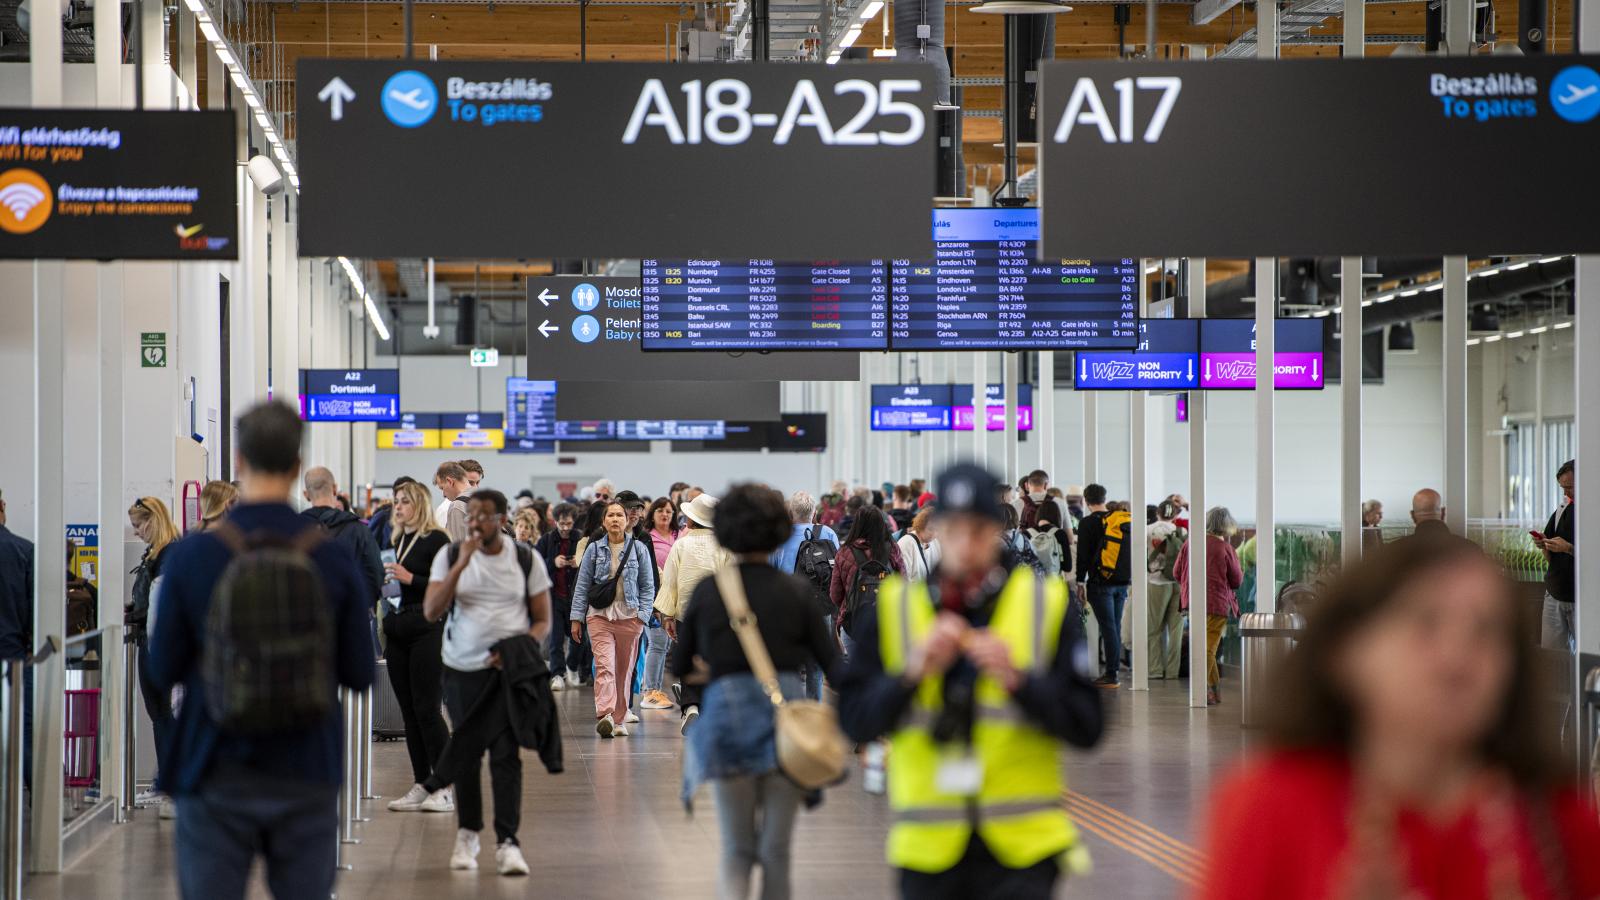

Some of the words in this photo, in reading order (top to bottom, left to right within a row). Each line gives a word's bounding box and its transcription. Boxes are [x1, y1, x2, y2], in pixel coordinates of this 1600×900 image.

[447, 77, 552, 99] Beszállás
[1430, 72, 1538, 96] Beszállás
[448, 100, 477, 121] To
[480, 101, 543, 126] gates
[621, 78, 925, 145] A18-A25
[1053, 77, 1182, 143] A17
[1440, 95, 1470, 118] To
[1473, 98, 1537, 122] gates
[23, 144, 47, 160] for
[50, 146, 83, 164] you
[994, 220, 1038, 228] Departures
[605, 298, 641, 308] Toilets
[605, 330, 634, 341] Baby
[1138, 362, 1160, 370] NON
[1273, 366, 1307, 374] IORITY
[345, 372, 361, 381] A22
[1138, 371, 1182, 379] PRIORITY
[330, 384, 376, 394] Dortmund
[353, 408, 387, 416] PRIORITY
